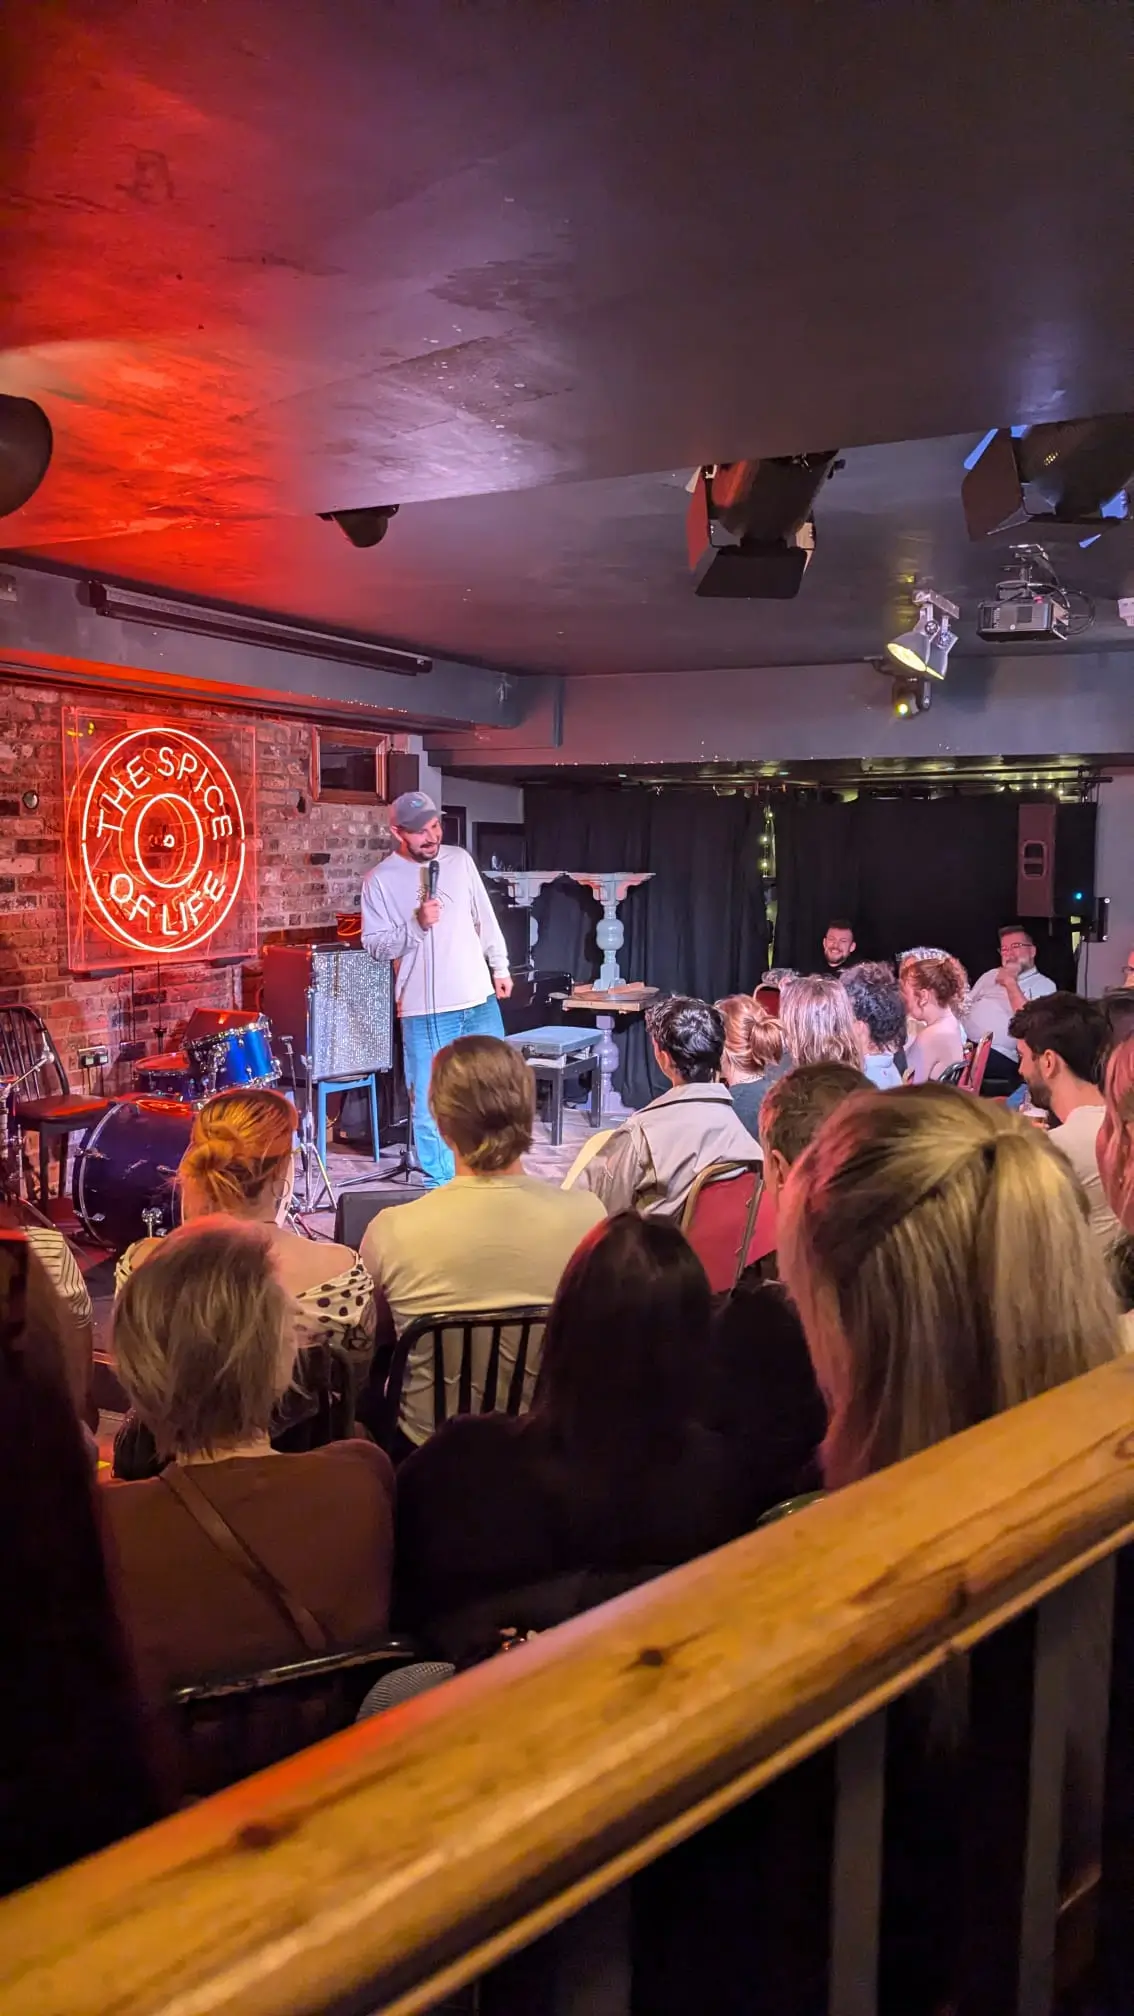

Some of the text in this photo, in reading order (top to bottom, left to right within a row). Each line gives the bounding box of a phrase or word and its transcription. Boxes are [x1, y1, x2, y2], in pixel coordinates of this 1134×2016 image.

[97, 747, 233, 840] THE SPICE
[110, 870, 226, 936] OF LIFE
